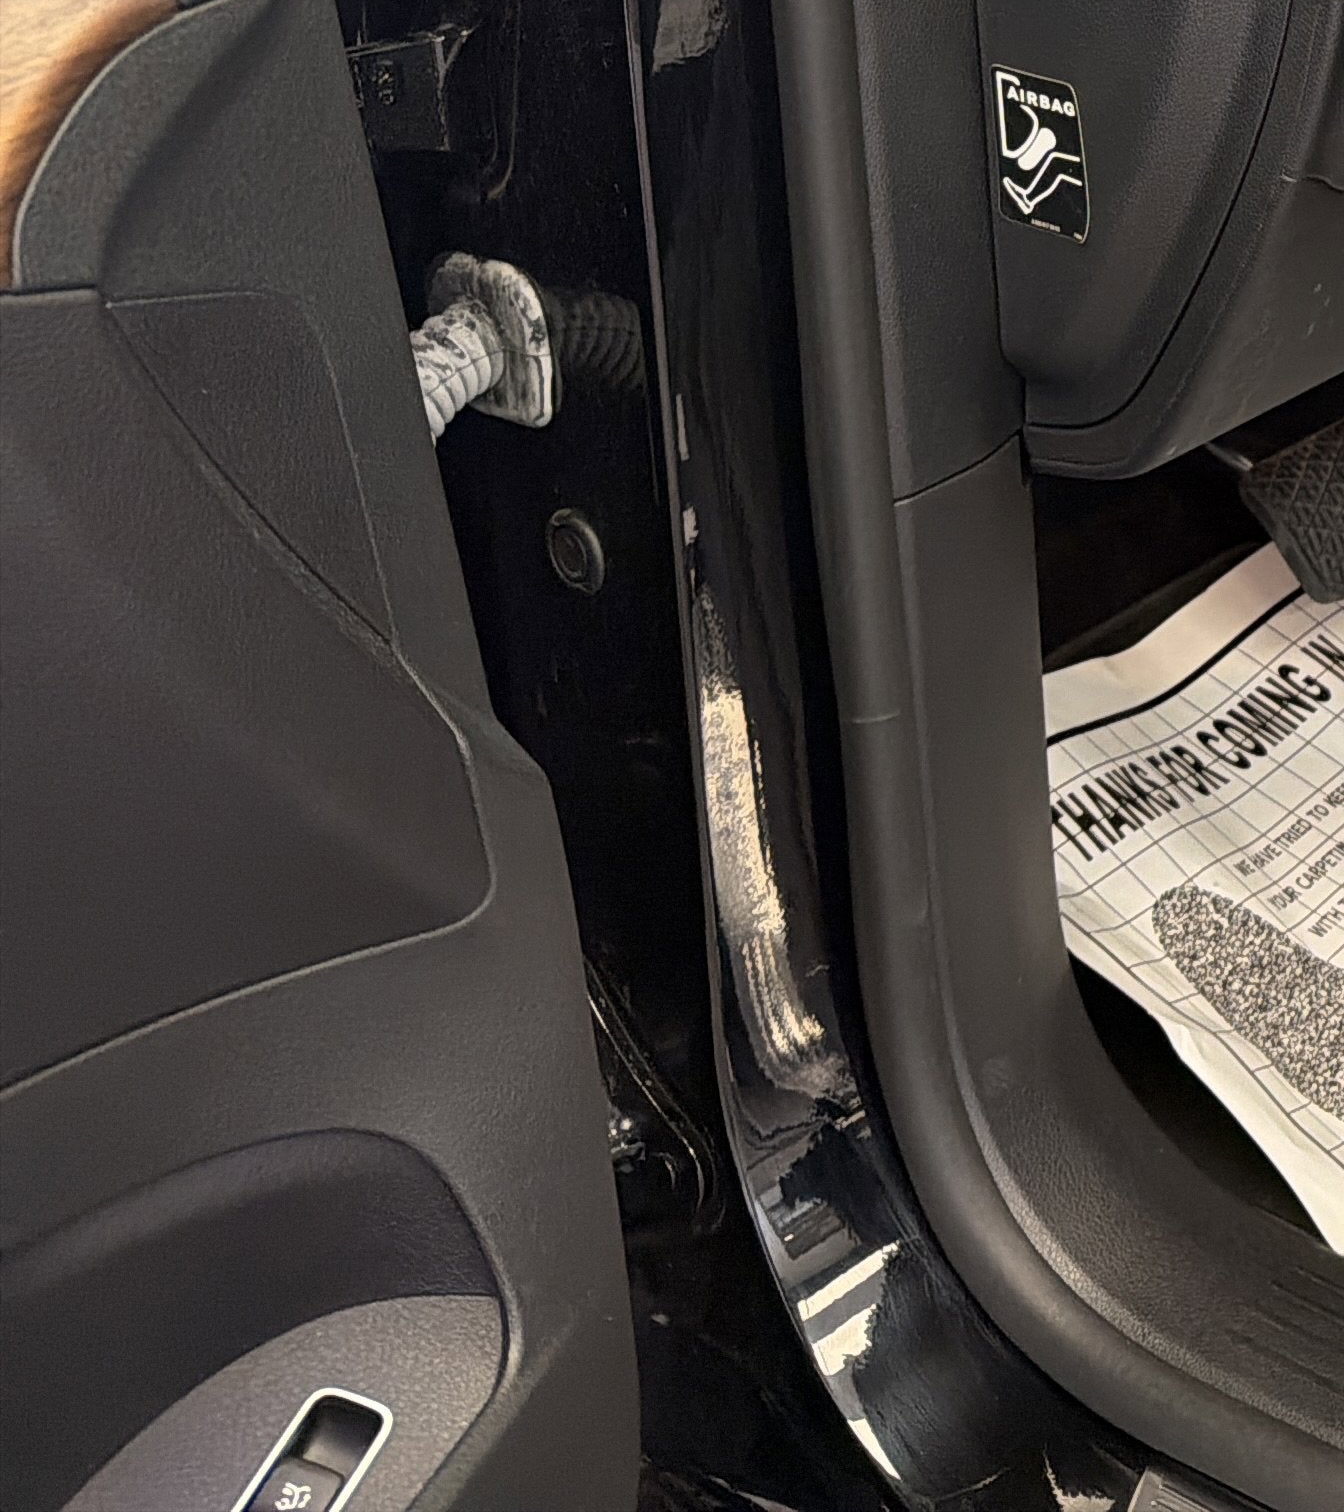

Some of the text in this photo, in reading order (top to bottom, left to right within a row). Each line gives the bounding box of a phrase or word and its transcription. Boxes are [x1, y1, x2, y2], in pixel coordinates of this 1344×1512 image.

[1006, 85, 1076, 117] AIRBAG
[1050, 762, 1180, 862] THANKS
[1148, 745, 1230, 802] FOR
[1196, 664, 1331, 770] COMING
[1250, 843, 1282, 870] HAVE
[1274, 818, 1312, 850] TRIED
[1306, 804, 1329, 822] TO
[1268, 886, 1302, 911] YOUR
